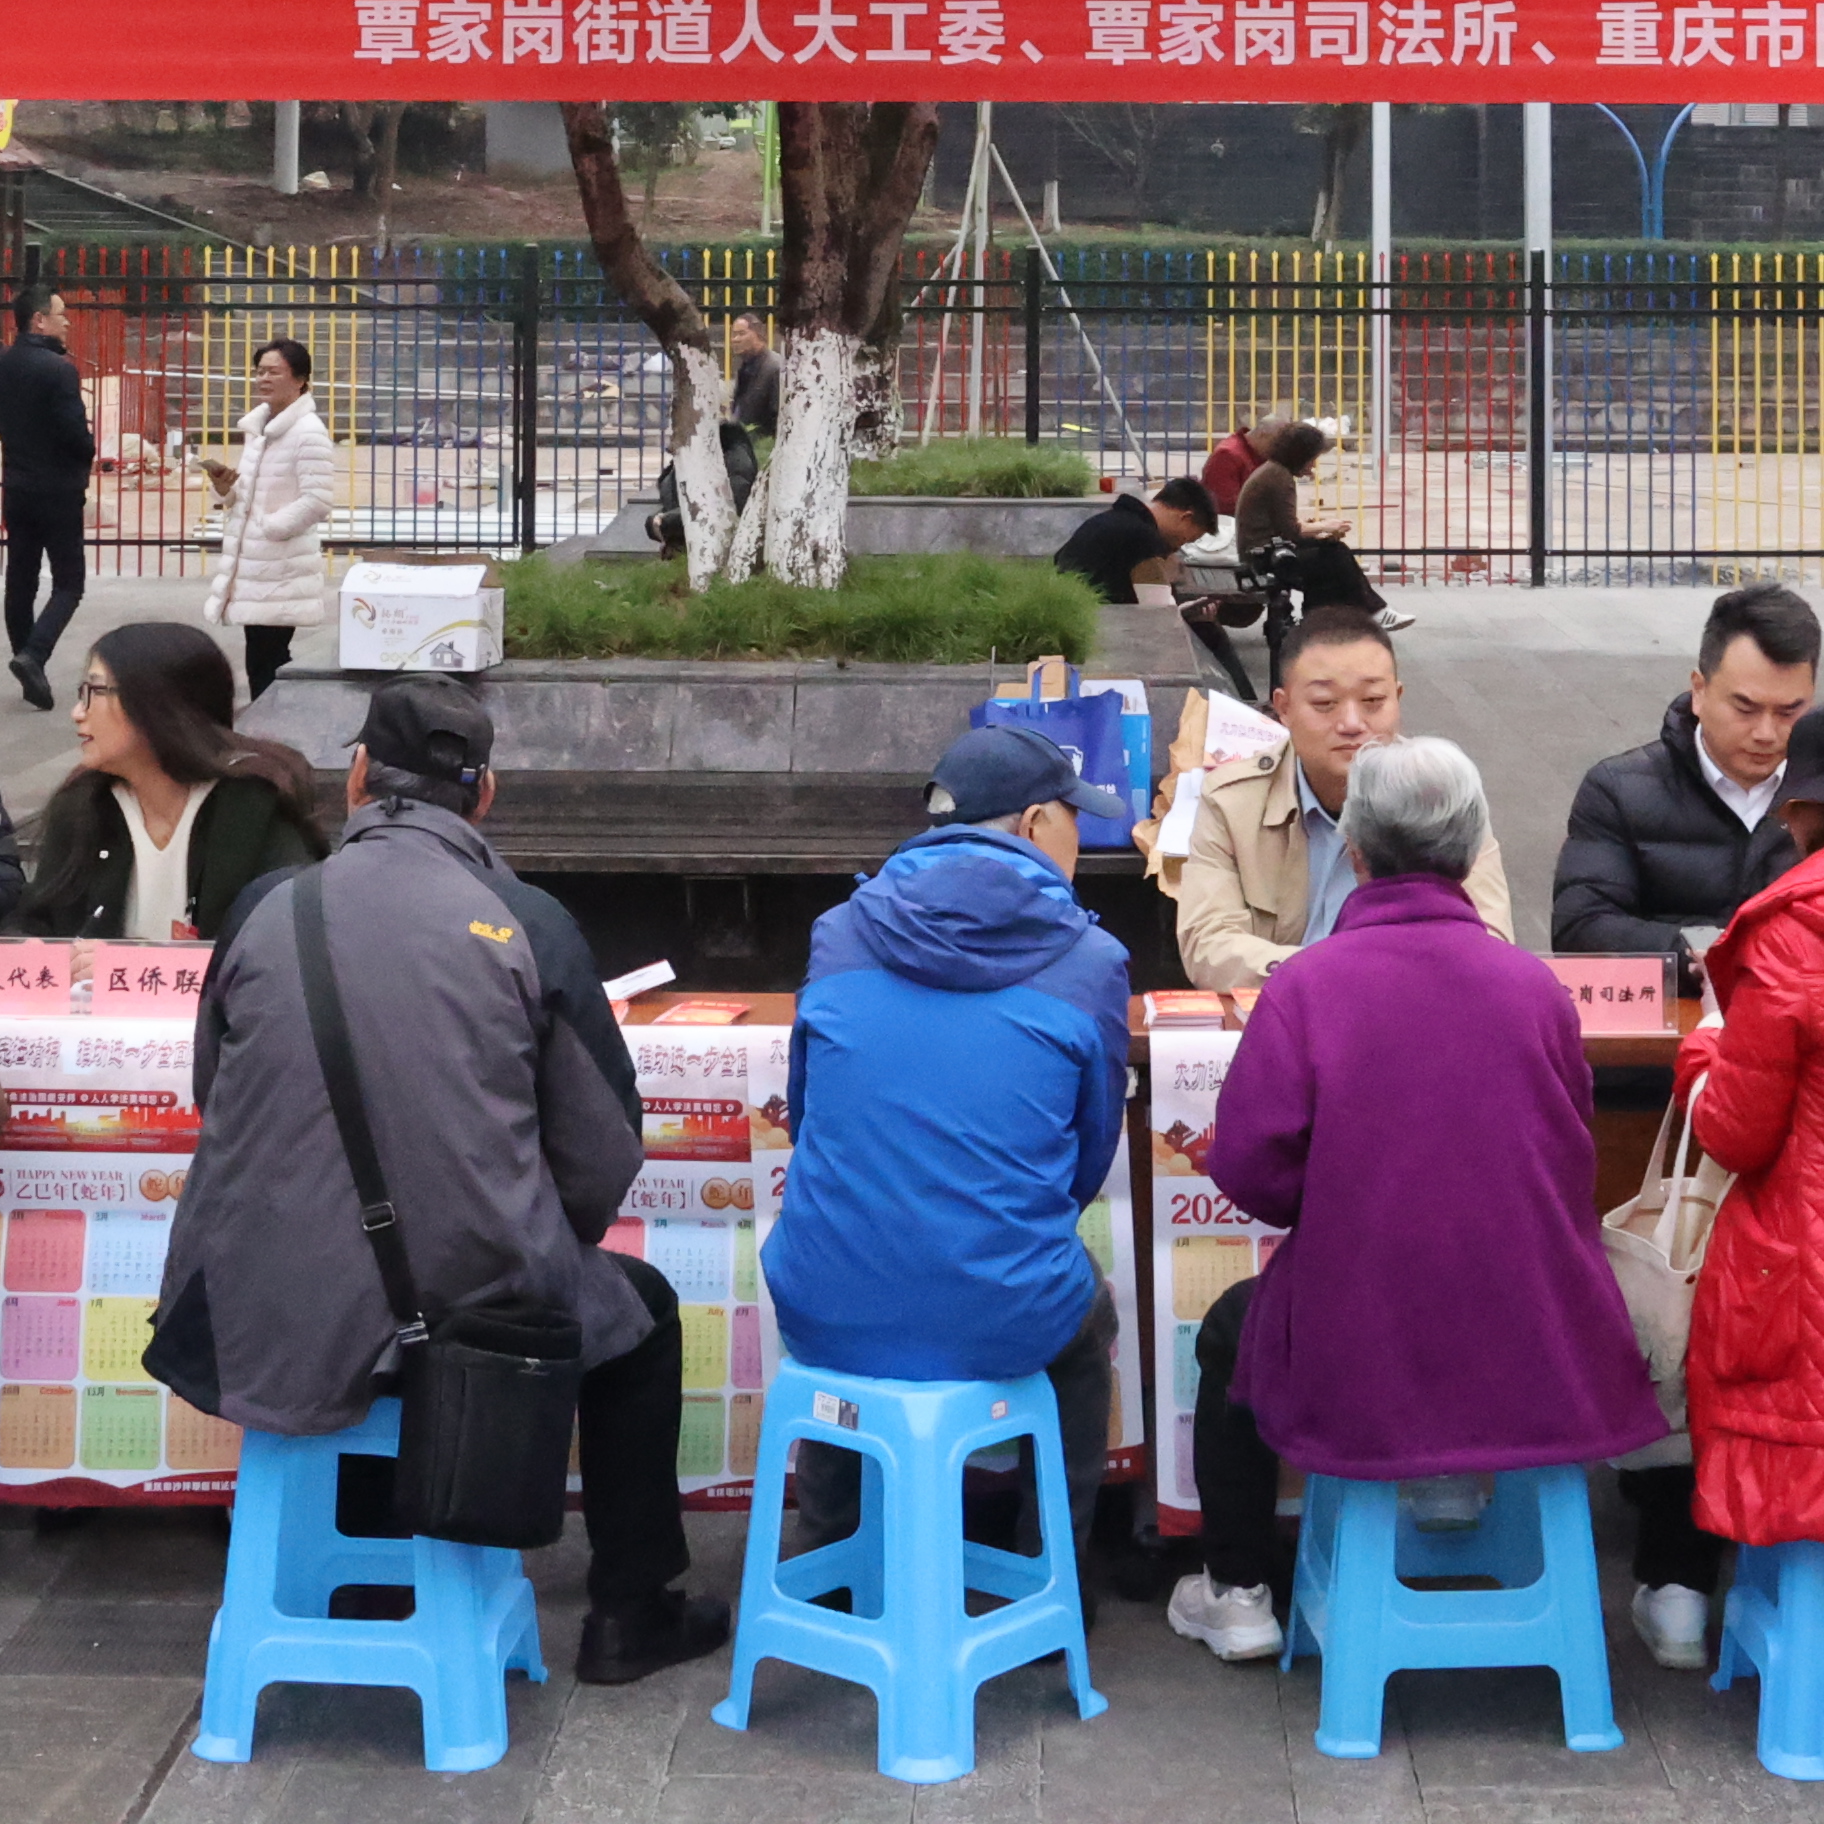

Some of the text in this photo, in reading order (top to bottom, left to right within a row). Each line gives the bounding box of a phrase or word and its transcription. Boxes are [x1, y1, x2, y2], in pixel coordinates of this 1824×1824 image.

[108, 965, 203, 995] 区侨联
[76, 1036, 193, 1069] 推动进一步全面
[1173, 1060, 1230, 1091] 大力弘
[17, 1169, 123, 1181] HAPPY NEW YEAR
[653, 1178, 685, 1188] YEAR
